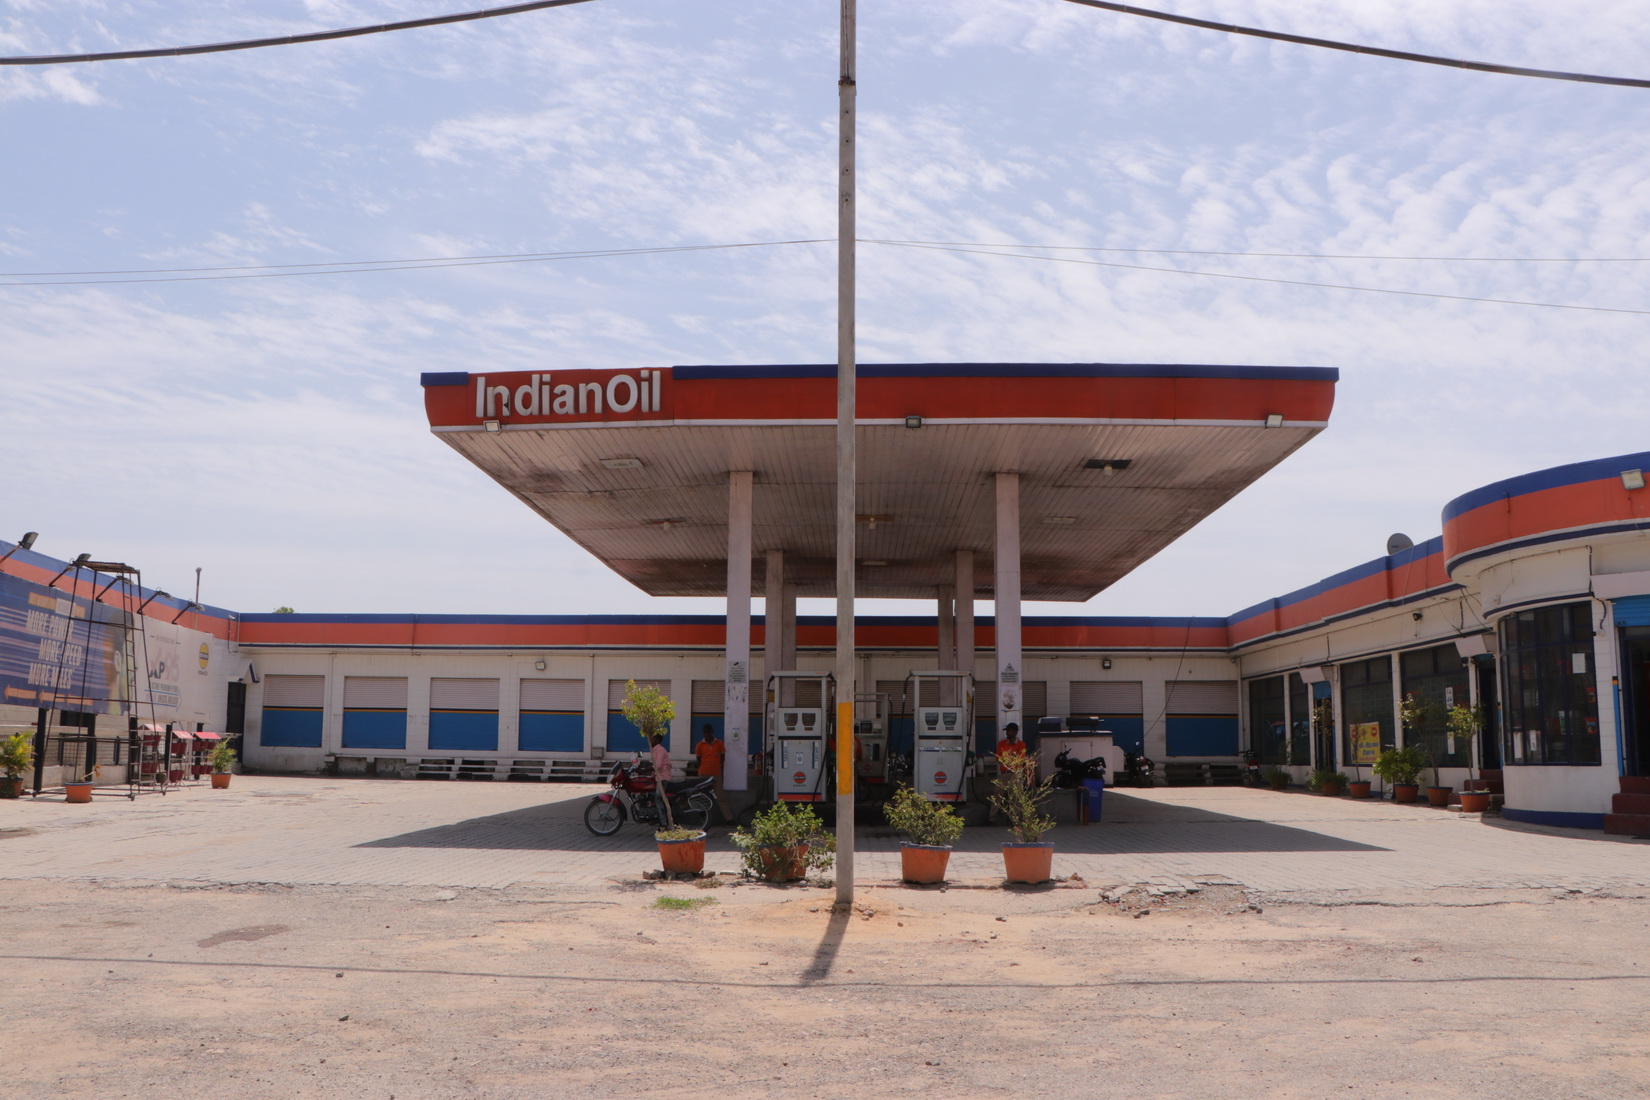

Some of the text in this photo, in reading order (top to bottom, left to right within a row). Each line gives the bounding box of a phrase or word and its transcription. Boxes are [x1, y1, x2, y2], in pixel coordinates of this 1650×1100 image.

[475, 369, 661, 418] IndianOil
[26, 609, 49, 633] MORE
[39, 638, 60, 662] MORE
[27, 662, 73, 690] MORE MLES
